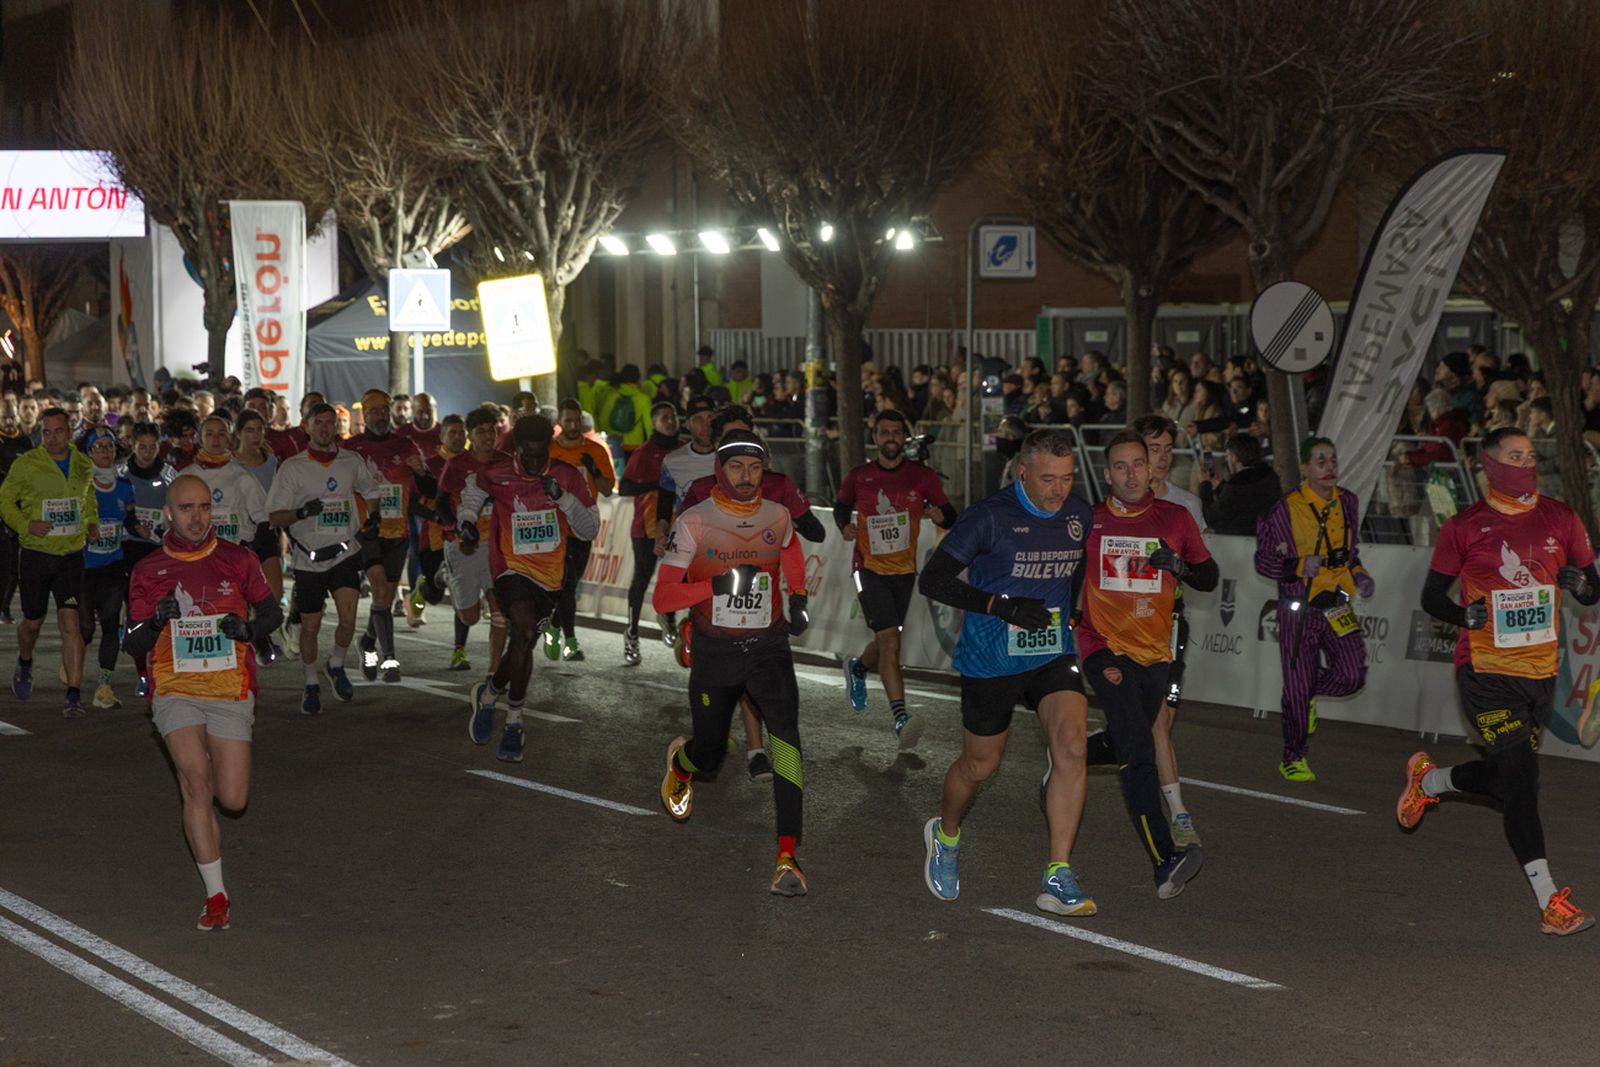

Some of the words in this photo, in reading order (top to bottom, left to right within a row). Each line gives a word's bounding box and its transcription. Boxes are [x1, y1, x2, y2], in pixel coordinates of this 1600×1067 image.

[27, 179, 129, 210] ANTÓN
[518, 525, 554, 540] 13750
[880, 527, 900, 541] 103
[1015, 551, 1040, 561] CLUB
[1512, 570, 1530, 586] 43
[1505, 606, 1546, 627] 8825
[185, 635, 222, 653] 7401
[1016, 629, 1058, 649] 8555
[1200, 633, 1243, 655] MEDAC
